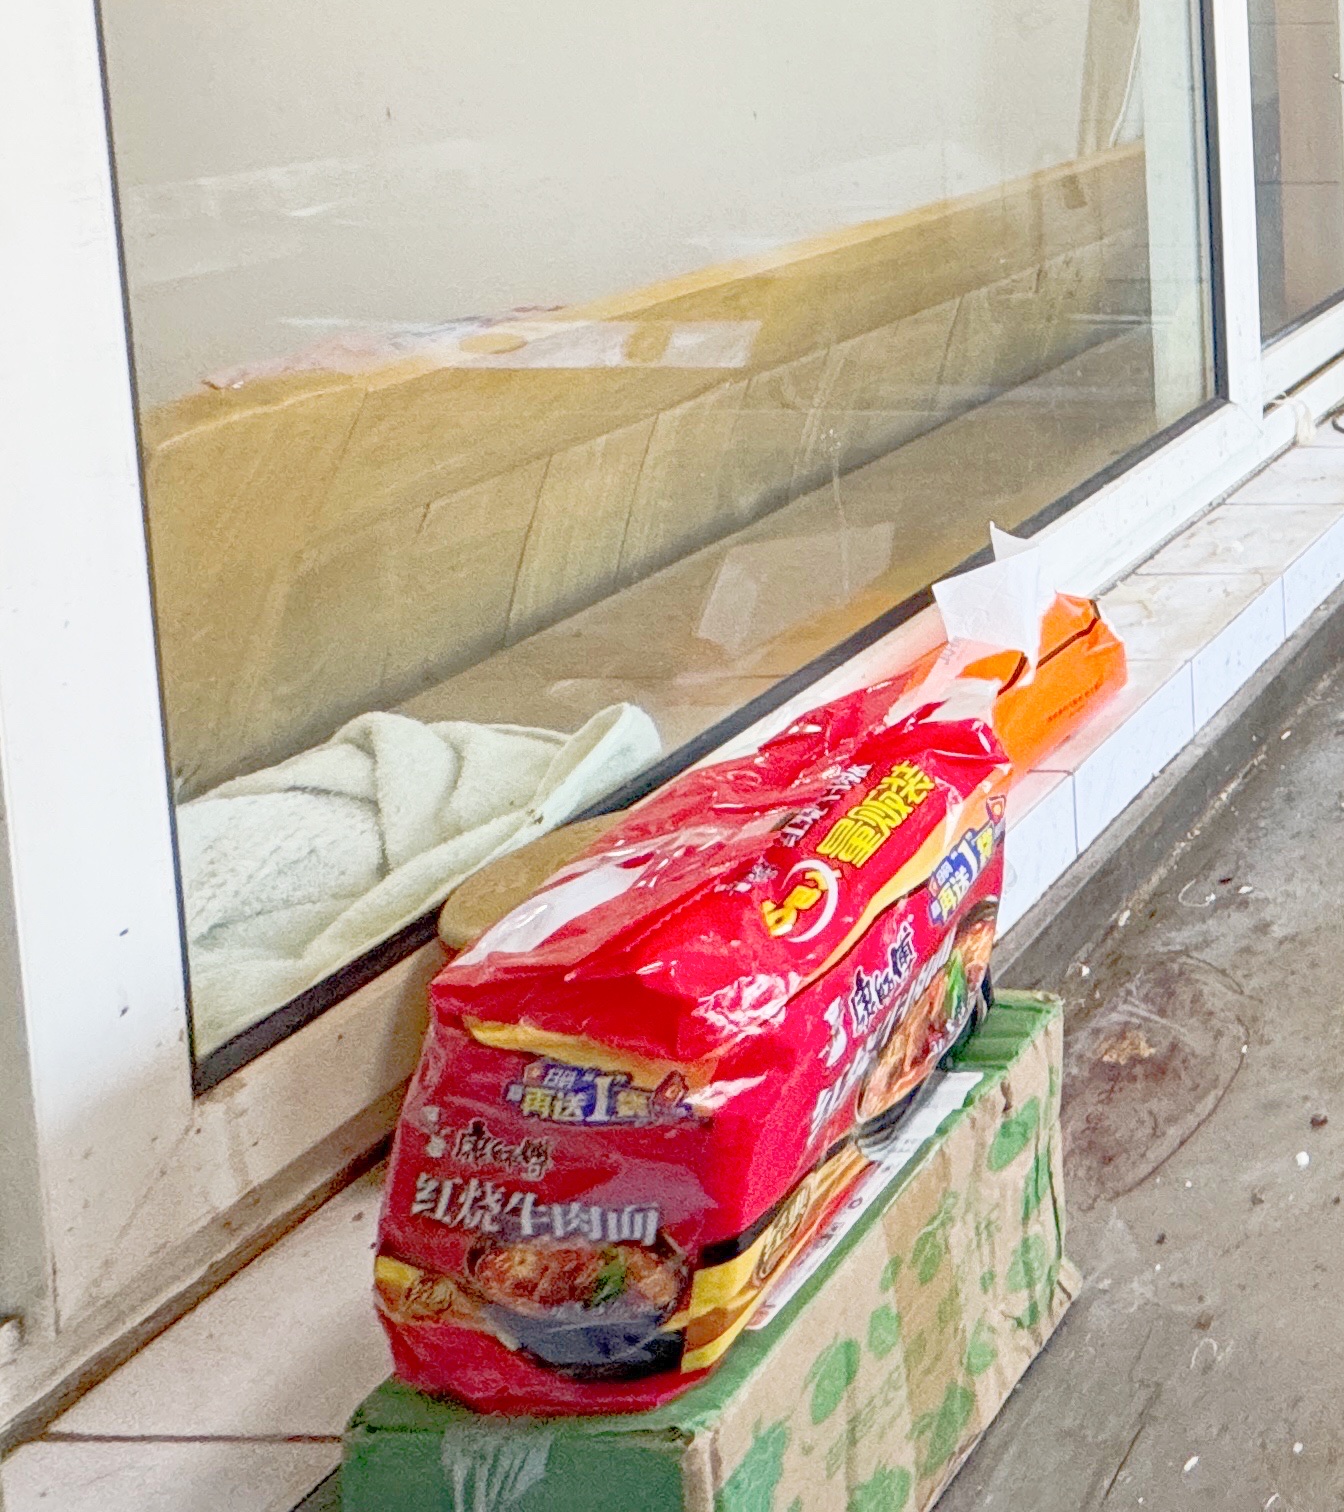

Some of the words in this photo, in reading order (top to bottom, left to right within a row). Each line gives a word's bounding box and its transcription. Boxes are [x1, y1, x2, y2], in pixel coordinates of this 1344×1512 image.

[816, 760, 935, 868] 量贩装
[411, 1172, 659, 1246] 红烧牛肉面
